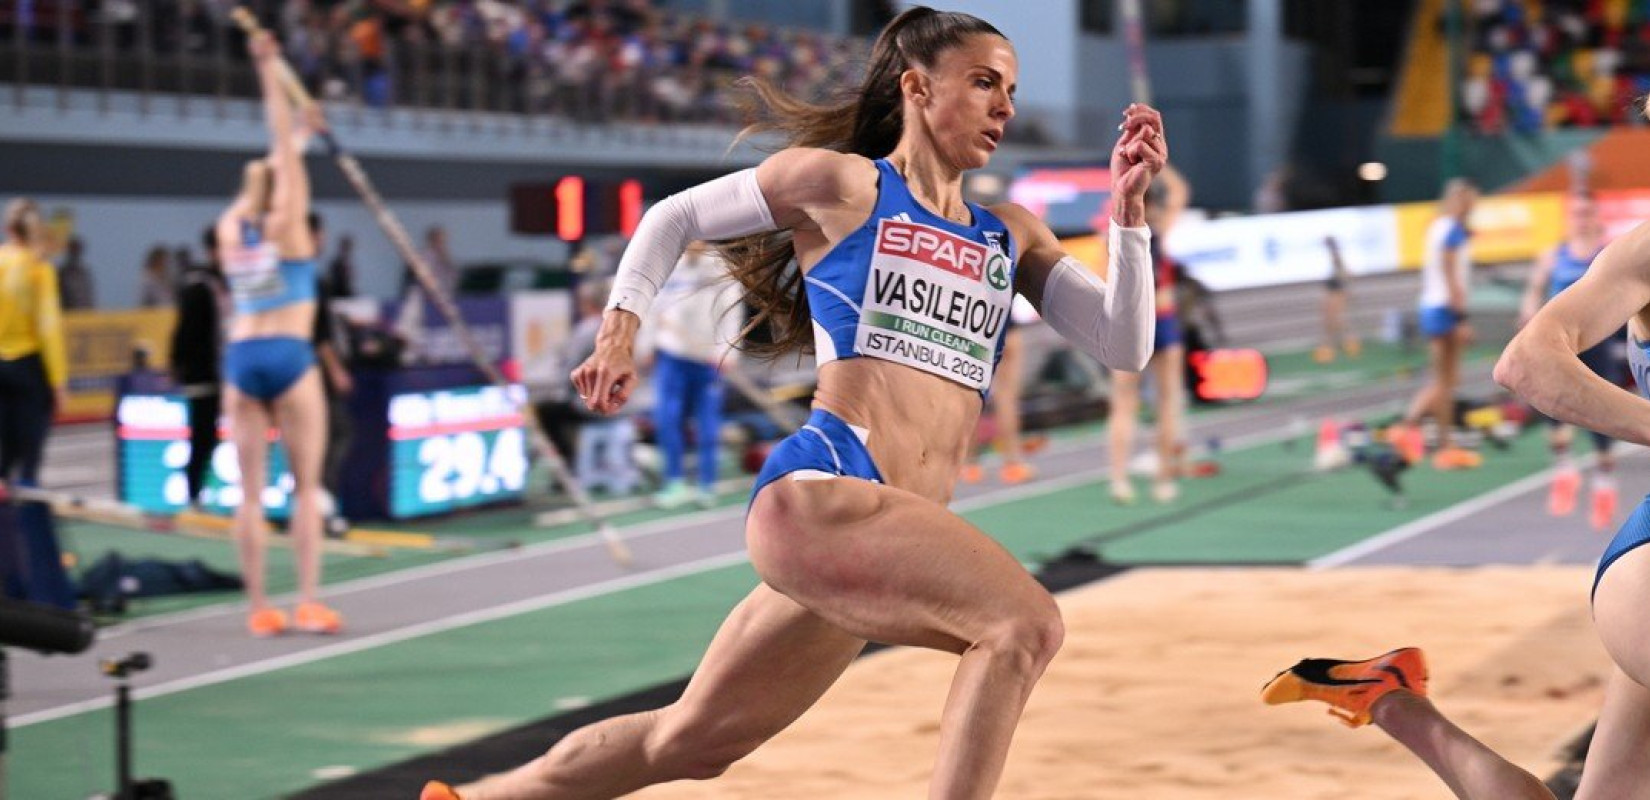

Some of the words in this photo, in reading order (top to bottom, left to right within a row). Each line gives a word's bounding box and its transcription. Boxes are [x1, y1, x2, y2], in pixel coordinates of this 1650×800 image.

[882, 226, 984, 277] SPAR
[874, 268, 1004, 339] VASILEIOU
[865, 331, 949, 371] ISTANBUL
[951, 357, 985, 383] 2023
[894, 317, 899, 329] I
[901, 319, 930, 338] RUN
[930, 329, 970, 352] CLEAN
